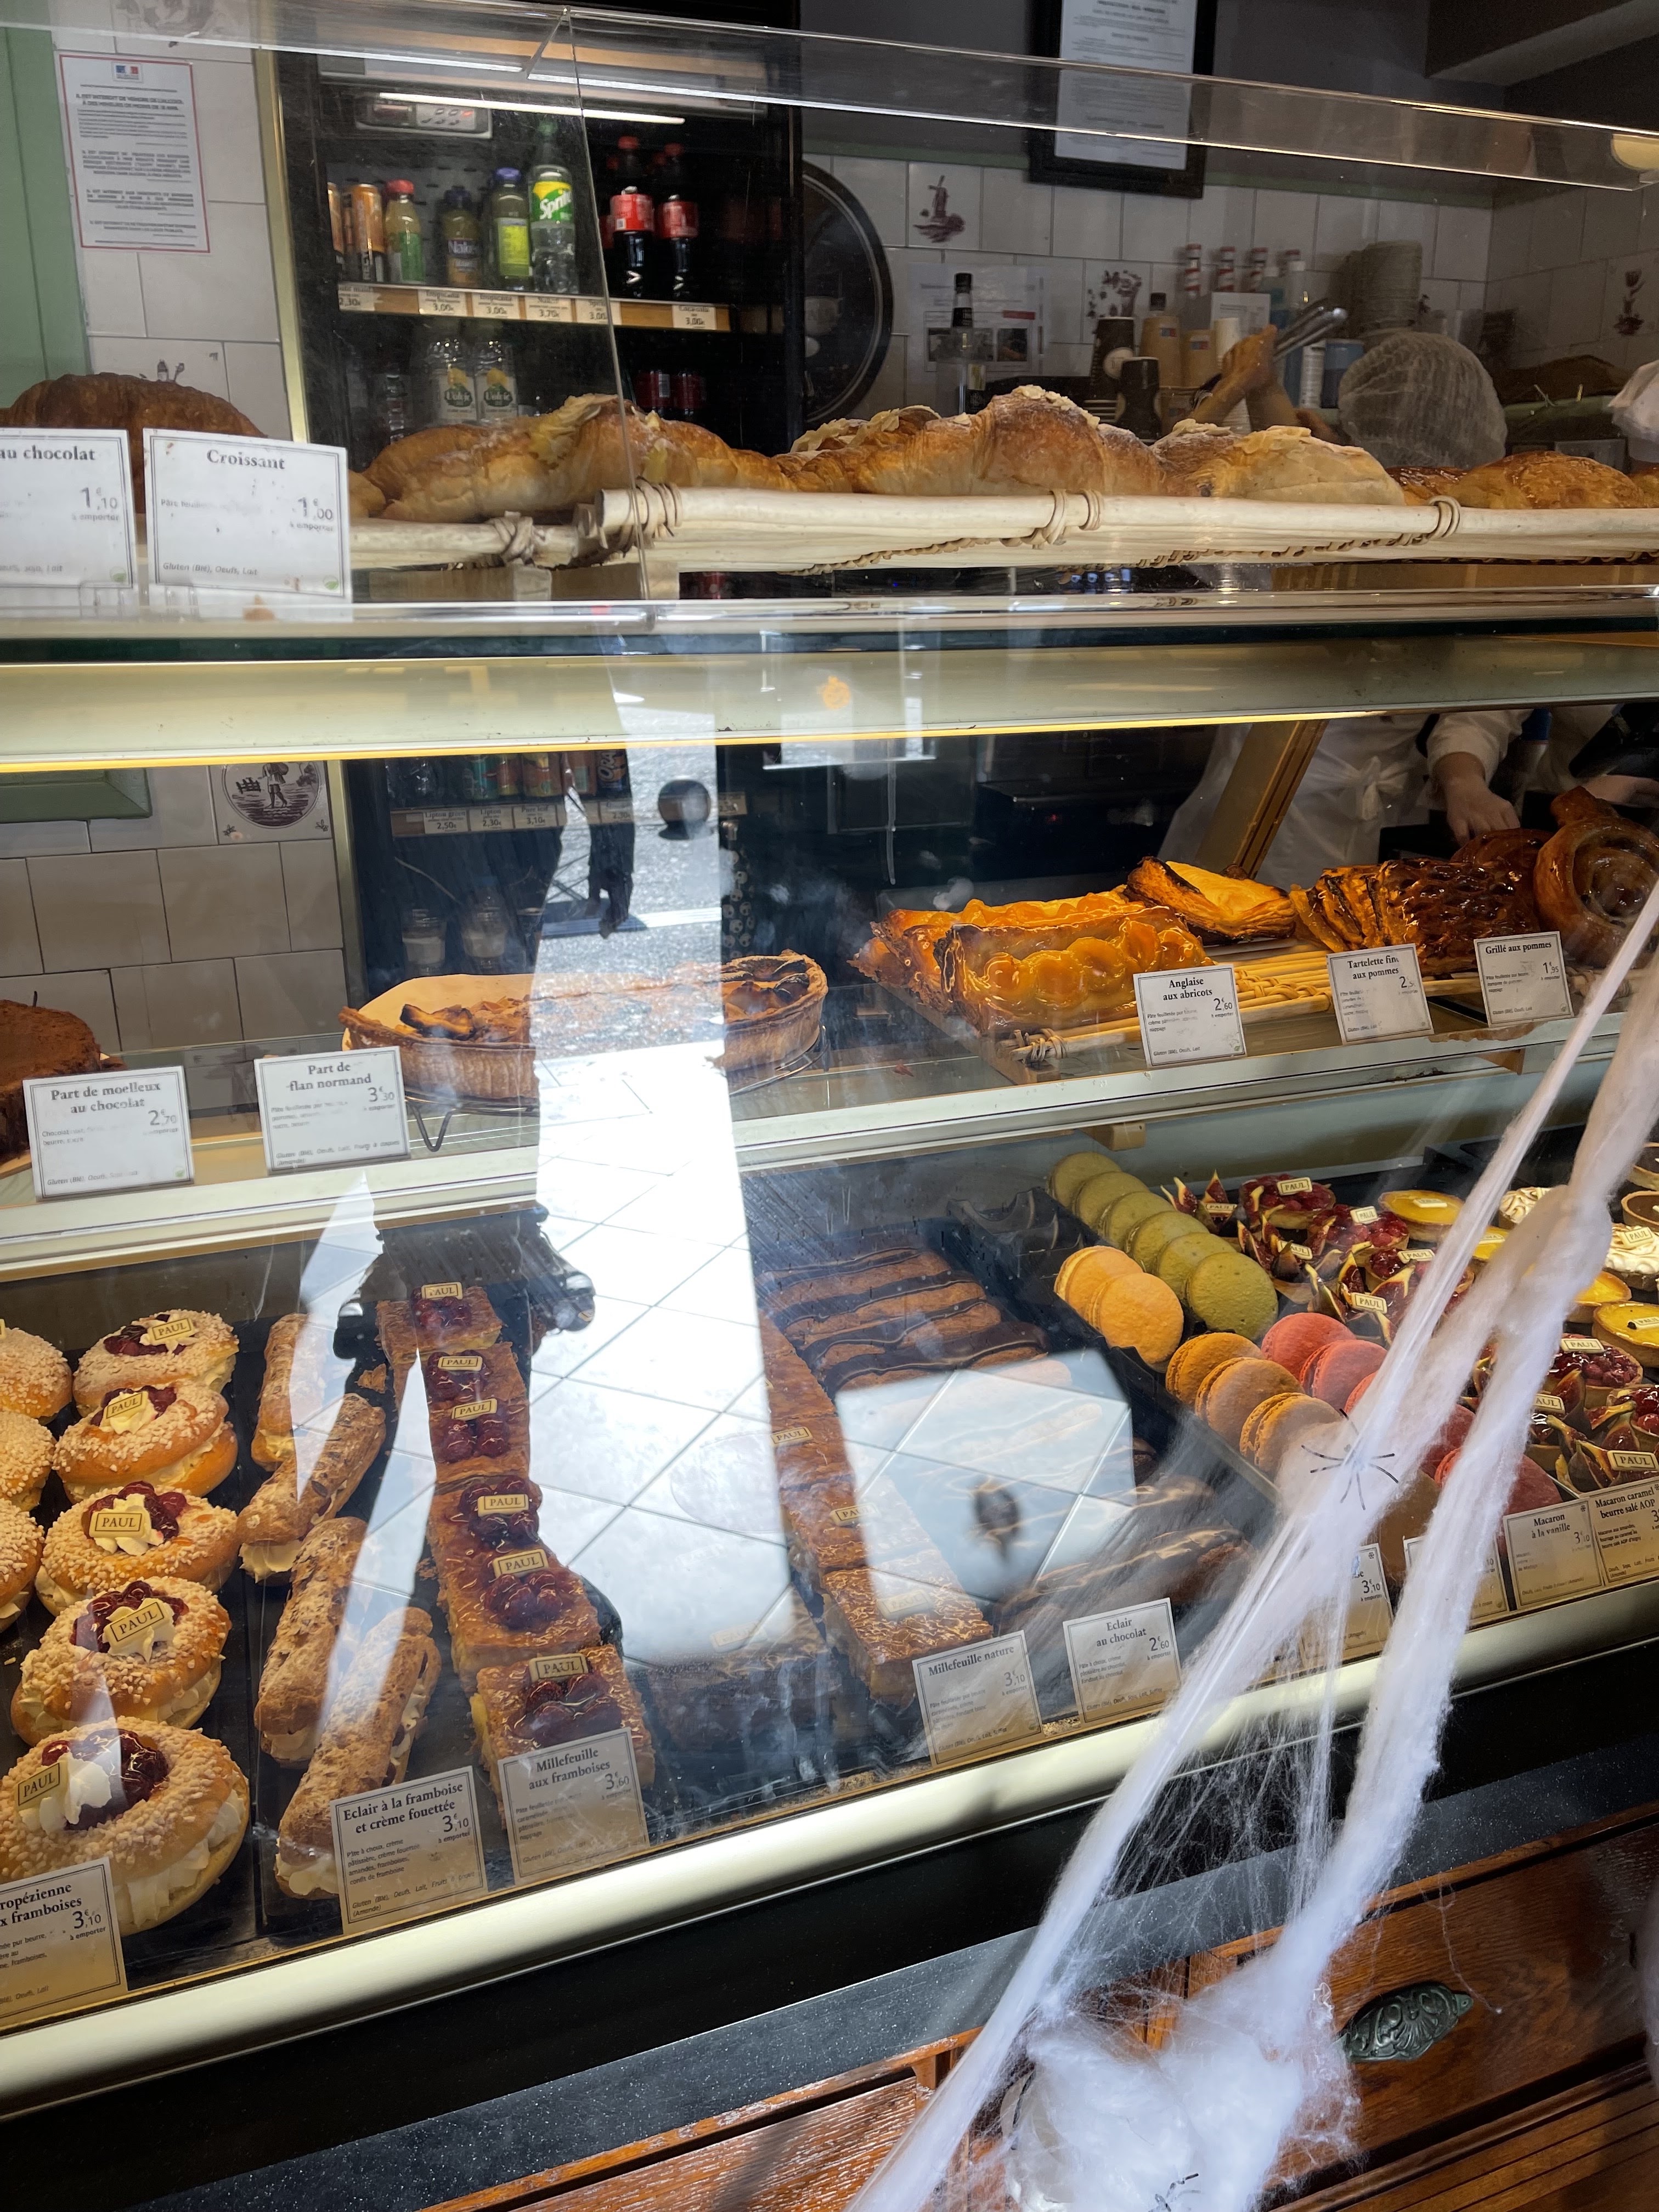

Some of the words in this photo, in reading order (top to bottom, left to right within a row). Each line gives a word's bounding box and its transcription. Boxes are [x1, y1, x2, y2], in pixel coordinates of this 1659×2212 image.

[23, 445, 96, 460] chocolat
[207, 449, 285, 470] Croissant
[163, 562, 189, 571] Gluten
[425, 811, 447, 820] Lipton
[1486, 945, 1506, 954] Grillé
[1523, 942, 1551, 953] pommes
[1347, 957, 1384, 968] Tartelette
[1368, 967, 1399, 980] pommes
[1169, 977, 1204, 989] Anglaise
[1163, 992, 1178, 1001] aux
[1180, 989, 1212, 999] abricots
[307, 1064, 334, 1075] Part
[337, 1062, 351, 1072] de
[289, 1080, 313, 1091] flan
[318, 1073, 371, 1089] normand
[50, 1090, 80, 1101] Part
[83, 1086, 98, 1098] de
[102, 1081, 161, 1096] moelleux
[71, 1105, 86, 1114] au
[91, 1098, 145, 1112] chocolat
[47, 1177, 69, 1186] Gluten
[1285, 1182, 1306, 1190] PAUL
[1359, 1210, 1375, 1220] PAUL
[1629, 1231, 1648, 1240] PAUL
[430, 1286, 455, 1296] PAUL
[1359, 1298, 1381, 1308] PAUL
[158, 1321, 187, 1336] PAUL
[111, 1397, 139, 1414] PAUL
[459, 1404, 488, 1415] PAUL
[775, 1429, 803, 1442] PAUL
[1620, 1455, 1650, 1465] PAUL
[489, 1497, 522, 1506] PAUL
[1595, 1495, 1626, 1508] Macaron
[1627, 1487, 1655, 1500] caramel
[842, 1504, 874, 1518] PAUL
[1600, 1508, 1624, 1519] beurre
[1625, 1502, 1638, 1513] salé
[1640, 1498, 1655, 1510] AOP
[101, 1517, 137, 1528] PAUL
[1534, 1514, 1565, 1527] Macaron
[1532, 1531, 1536, 1539] à
[1547, 1523, 1571, 1535] vanille
[505, 1557, 539, 1571] PAUL
[119, 1610, 157, 1634] PAUL
[1106, 1618, 1132, 1632] Eclair
[1110, 1628, 1147, 1644] chocolat
[928, 1654, 982, 1677] Millefeuille
[984, 1645, 1014, 1661] nature
[543, 1662, 579, 1674] PAUL
[1006, 1685, 1028, 1696] emporter
[536, 1747, 599, 1773] Millefeuille
[528, 1778, 549, 1791] aux
[552, 1760, 611, 1784] framboises
[23, 1772, 57, 1798] PAUL
[343, 1803, 379, 1822] Eclair
[382, 1800, 388, 1811] à
[392, 1797, 402, 1809] la
[406, 1782, 463, 1806] framboise
[356, 1822, 366, 1834] et
[370, 1813, 405, 1830] crème
[409, 1799, 455, 1820] fouettée
[443, 1831, 470, 1843] emporter
[347, 1849, 360, 1858] Pâte
[386, 1838, 403, 1848] crème
[348, 1854, 377, 1868] pâtissière,
[378, 1850, 396, 1859] crème
[522, 1854, 541, 1863] Gluten
[348, 1865, 376, 1876] amandes,
[377, 1857, 410, 1870] framboises,
[376, 1866, 404, 1878] framboise
[352, 1898, 371, 1909] Gluten
[12, 1897, 82, 1925] framboises
[353, 1905, 381, 1917] (Amande)
[76, 1926, 106, 1940] emporter
[13, 1939, 22, 1948] pur
[25, 1933, 47, 1944] beurre,
[37, 1985, 49, 1994] Lait
